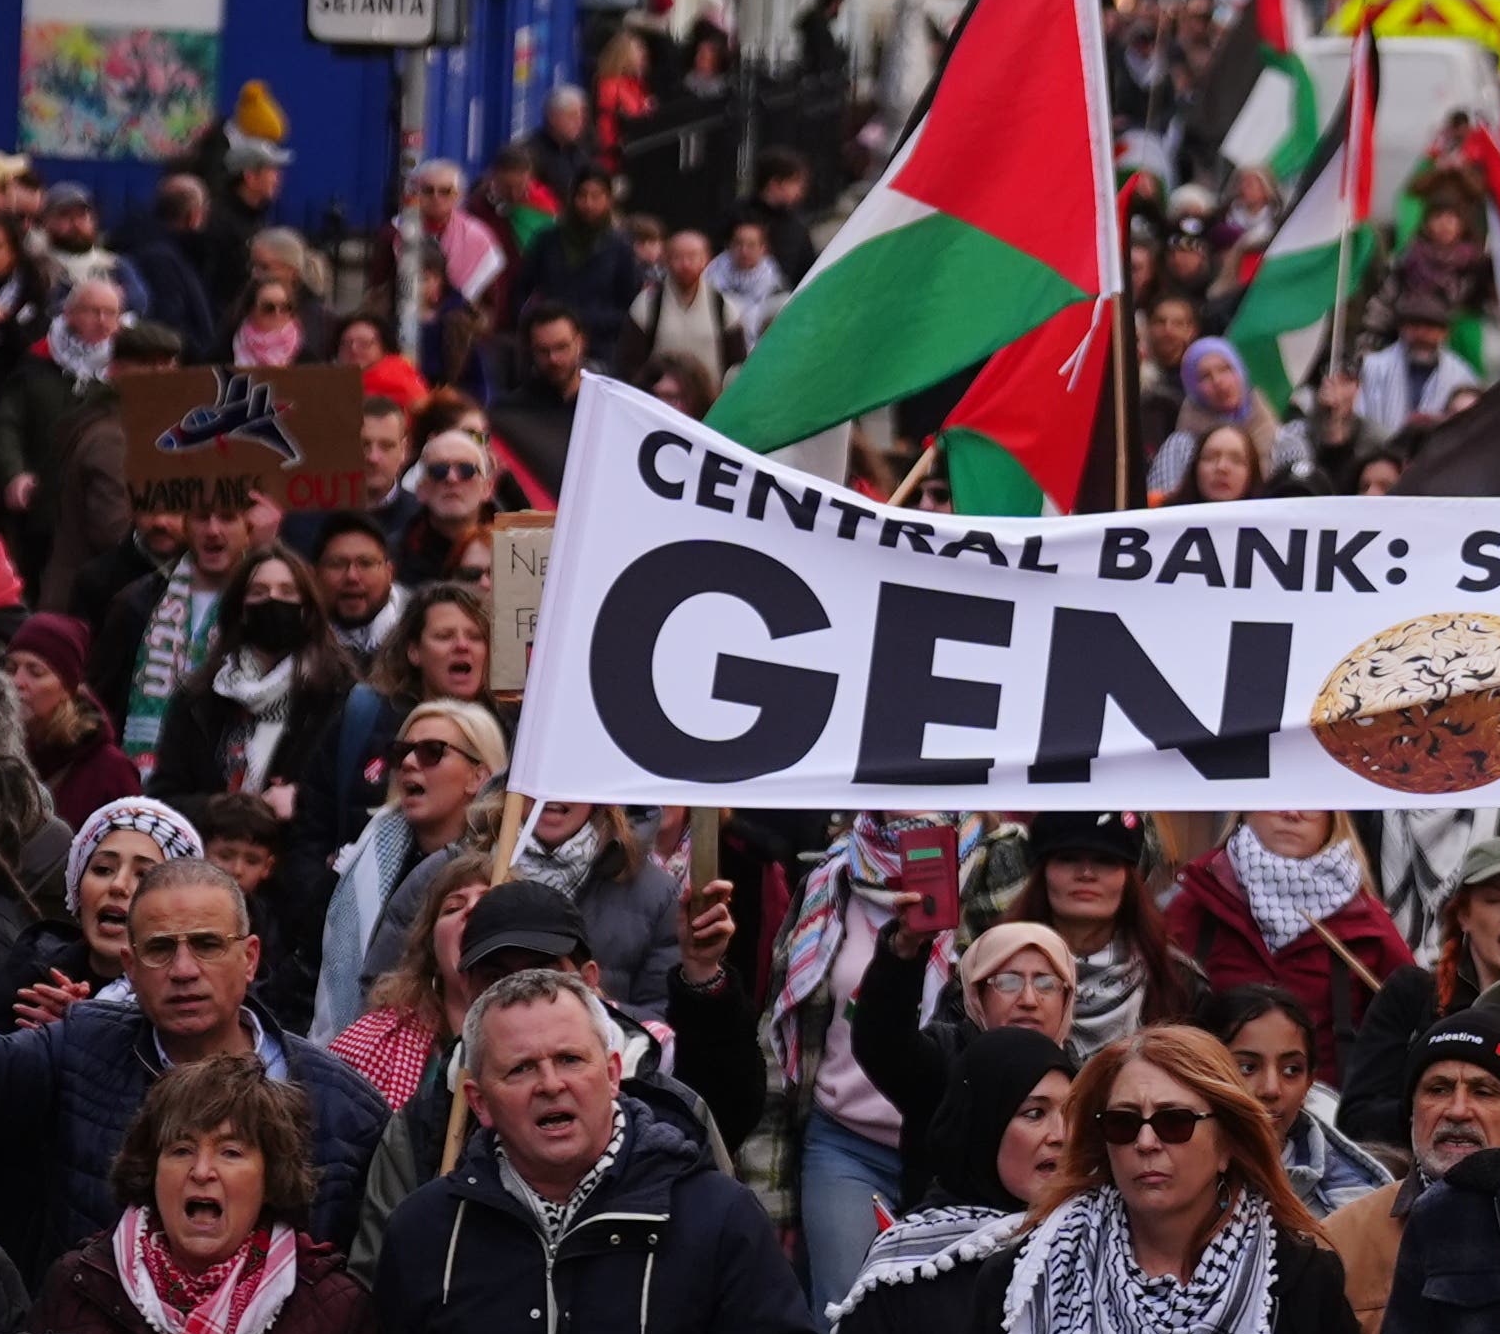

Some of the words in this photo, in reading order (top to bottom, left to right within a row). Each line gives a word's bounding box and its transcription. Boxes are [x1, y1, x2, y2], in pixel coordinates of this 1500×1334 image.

[285, 471, 364, 509] OUT
[637, 429, 1059, 575] CENTRAL
[1098, 526, 1411, 593] BANK:
[1428, 1032, 1484, 1046] Palestine
